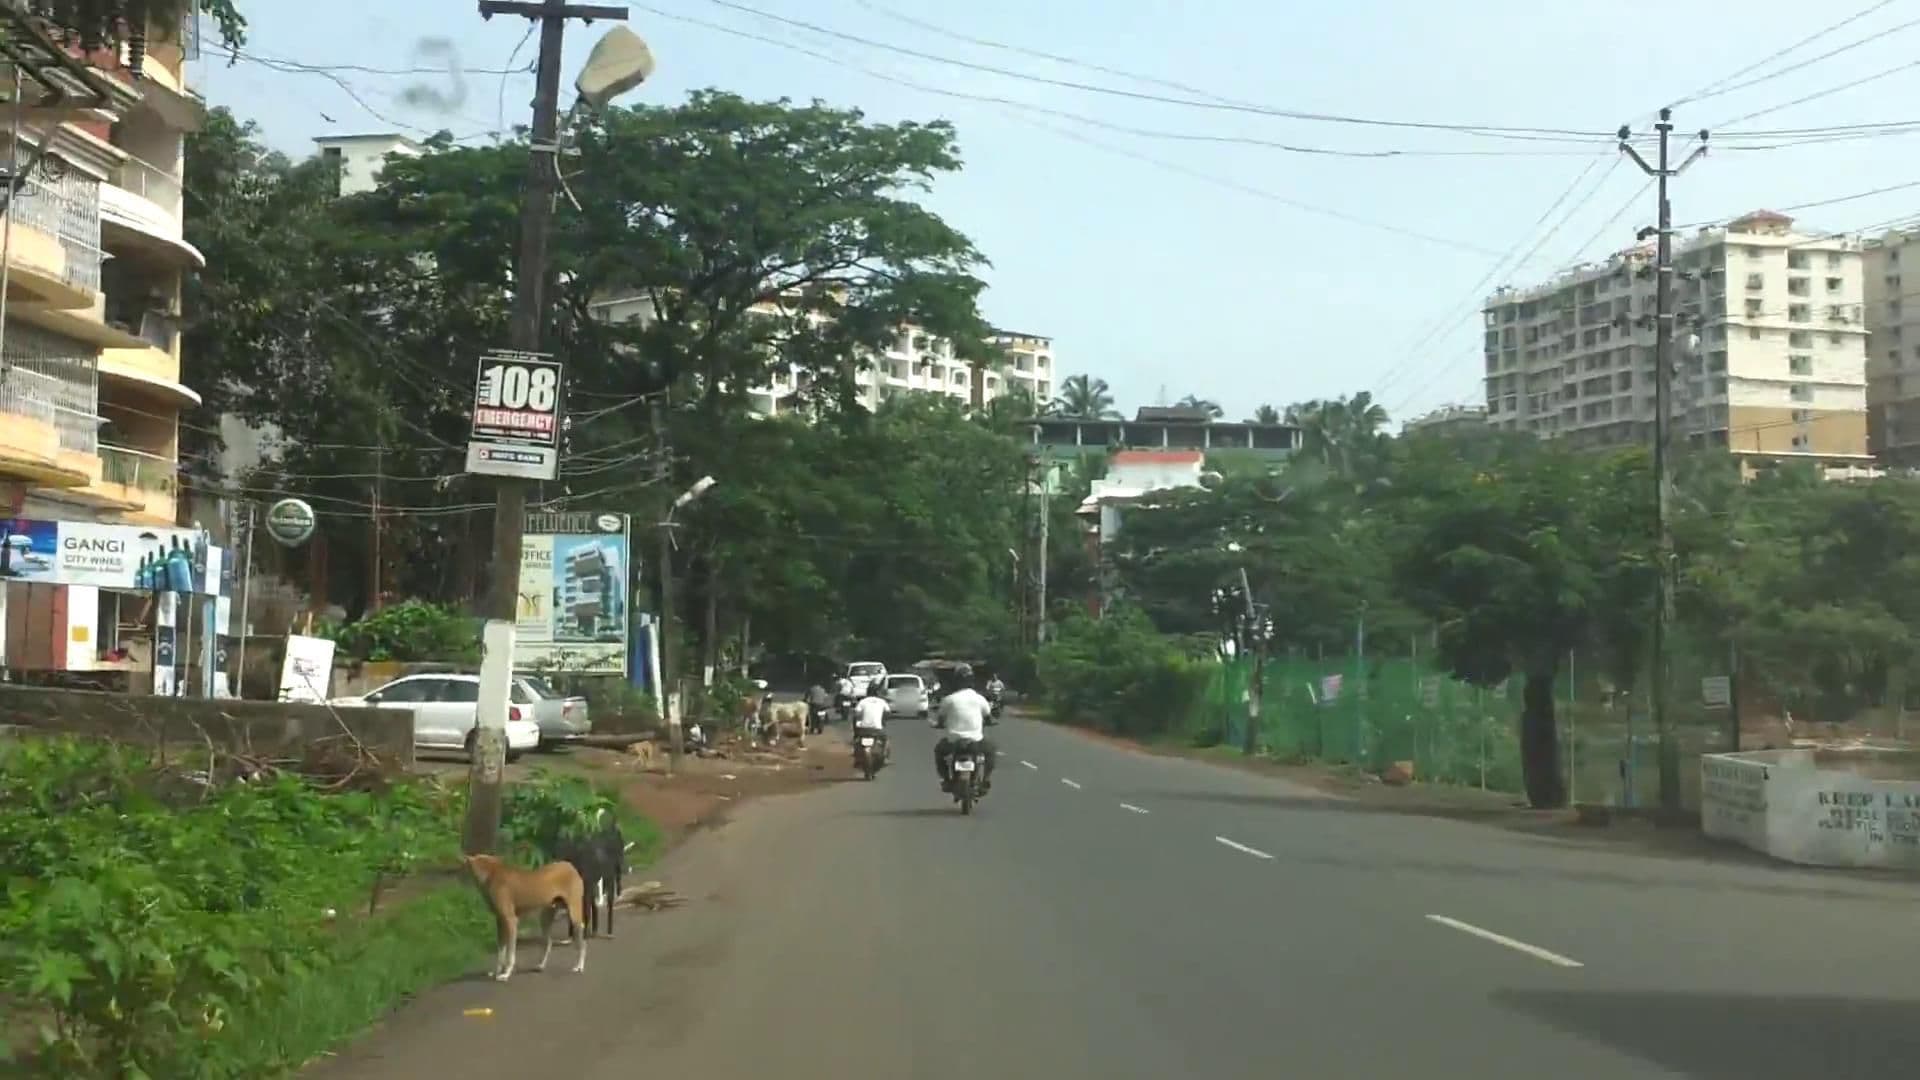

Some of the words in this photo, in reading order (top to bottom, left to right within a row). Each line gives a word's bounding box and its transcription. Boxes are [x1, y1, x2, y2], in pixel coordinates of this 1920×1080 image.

[484, 365, 555, 411] 108
[477, 409, 552, 431] EMERGENCY
[64, 537, 124, 553] GANGI
[65, 554, 88, 564] CITY
[90, 557, 122, 566] WINES
[1818, 791, 1873, 806] KEEP
